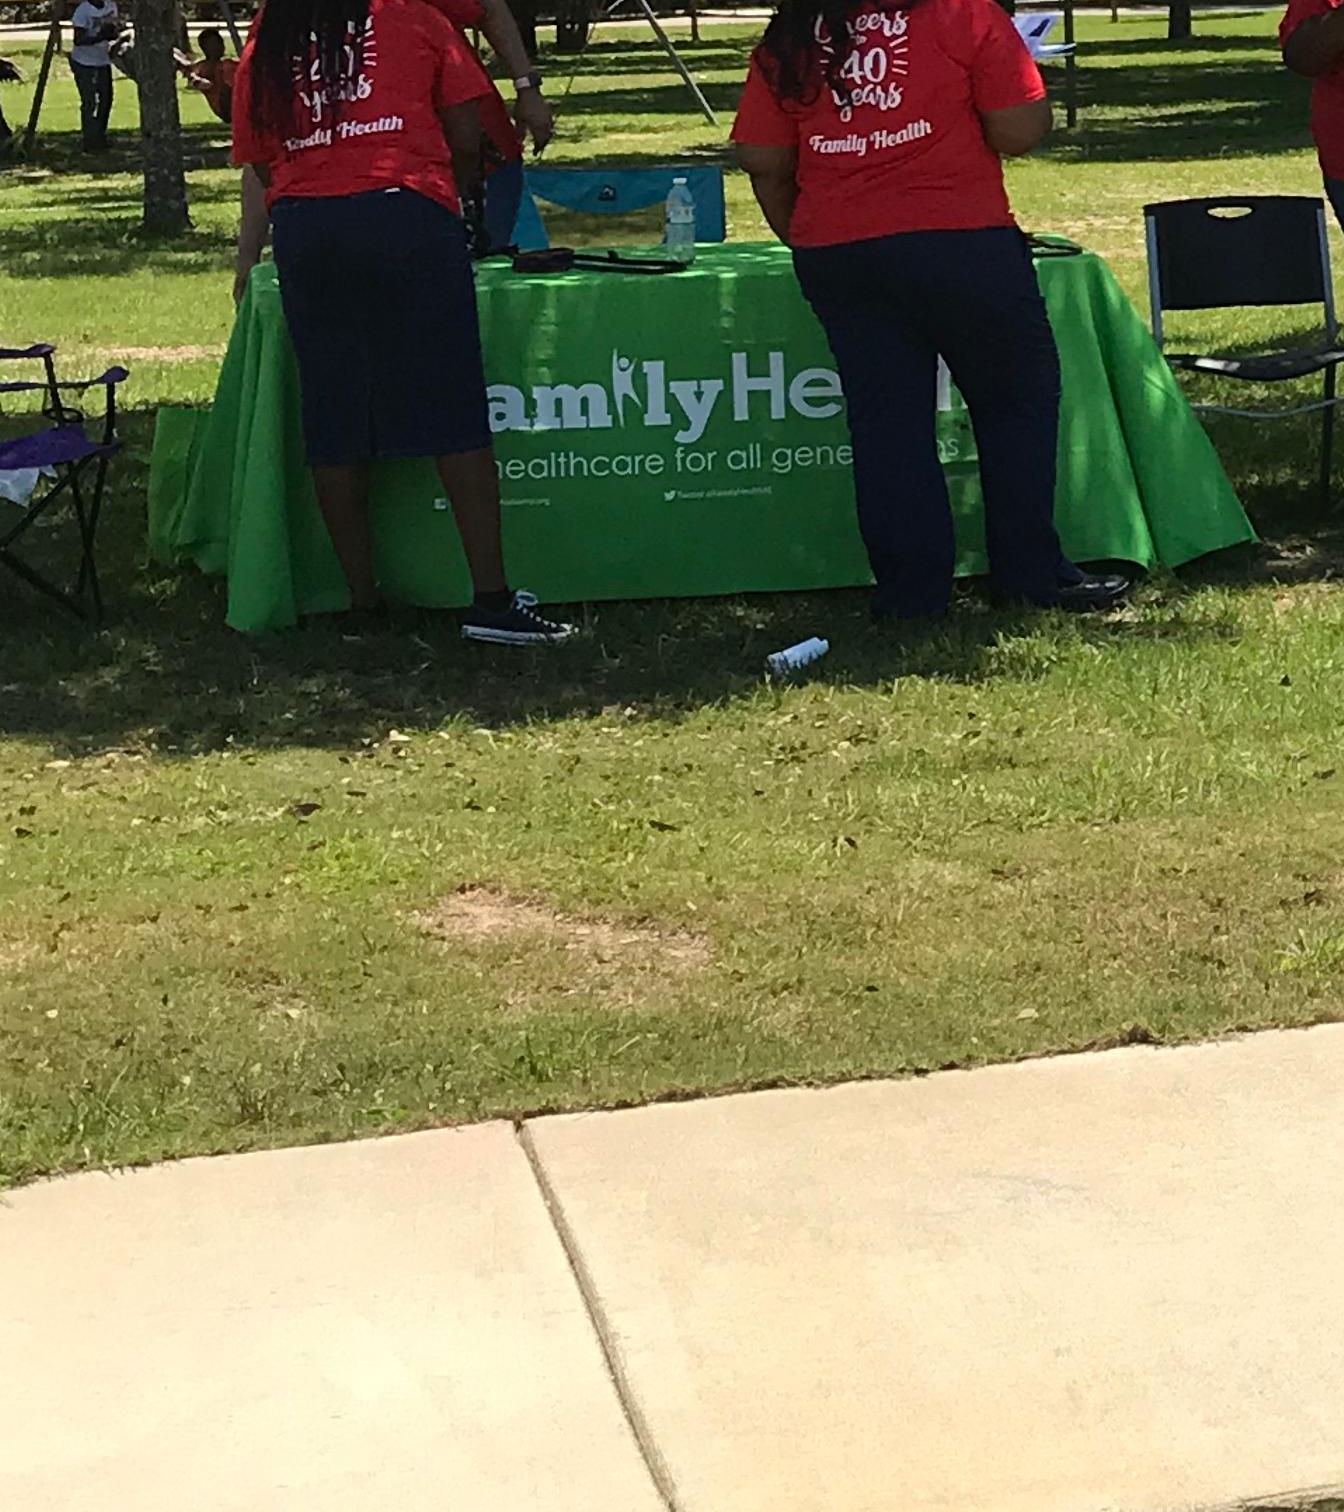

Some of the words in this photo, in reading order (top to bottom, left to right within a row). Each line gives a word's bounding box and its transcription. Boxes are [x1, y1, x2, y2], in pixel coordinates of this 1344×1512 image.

[840, 47, 887, 85] 40
[336, 115, 404, 138] Health
[809, 134, 867, 156] Family
[869, 119, 932, 149] Health
[675, 446, 717, 473] for
[726, 442, 761, 471] all
